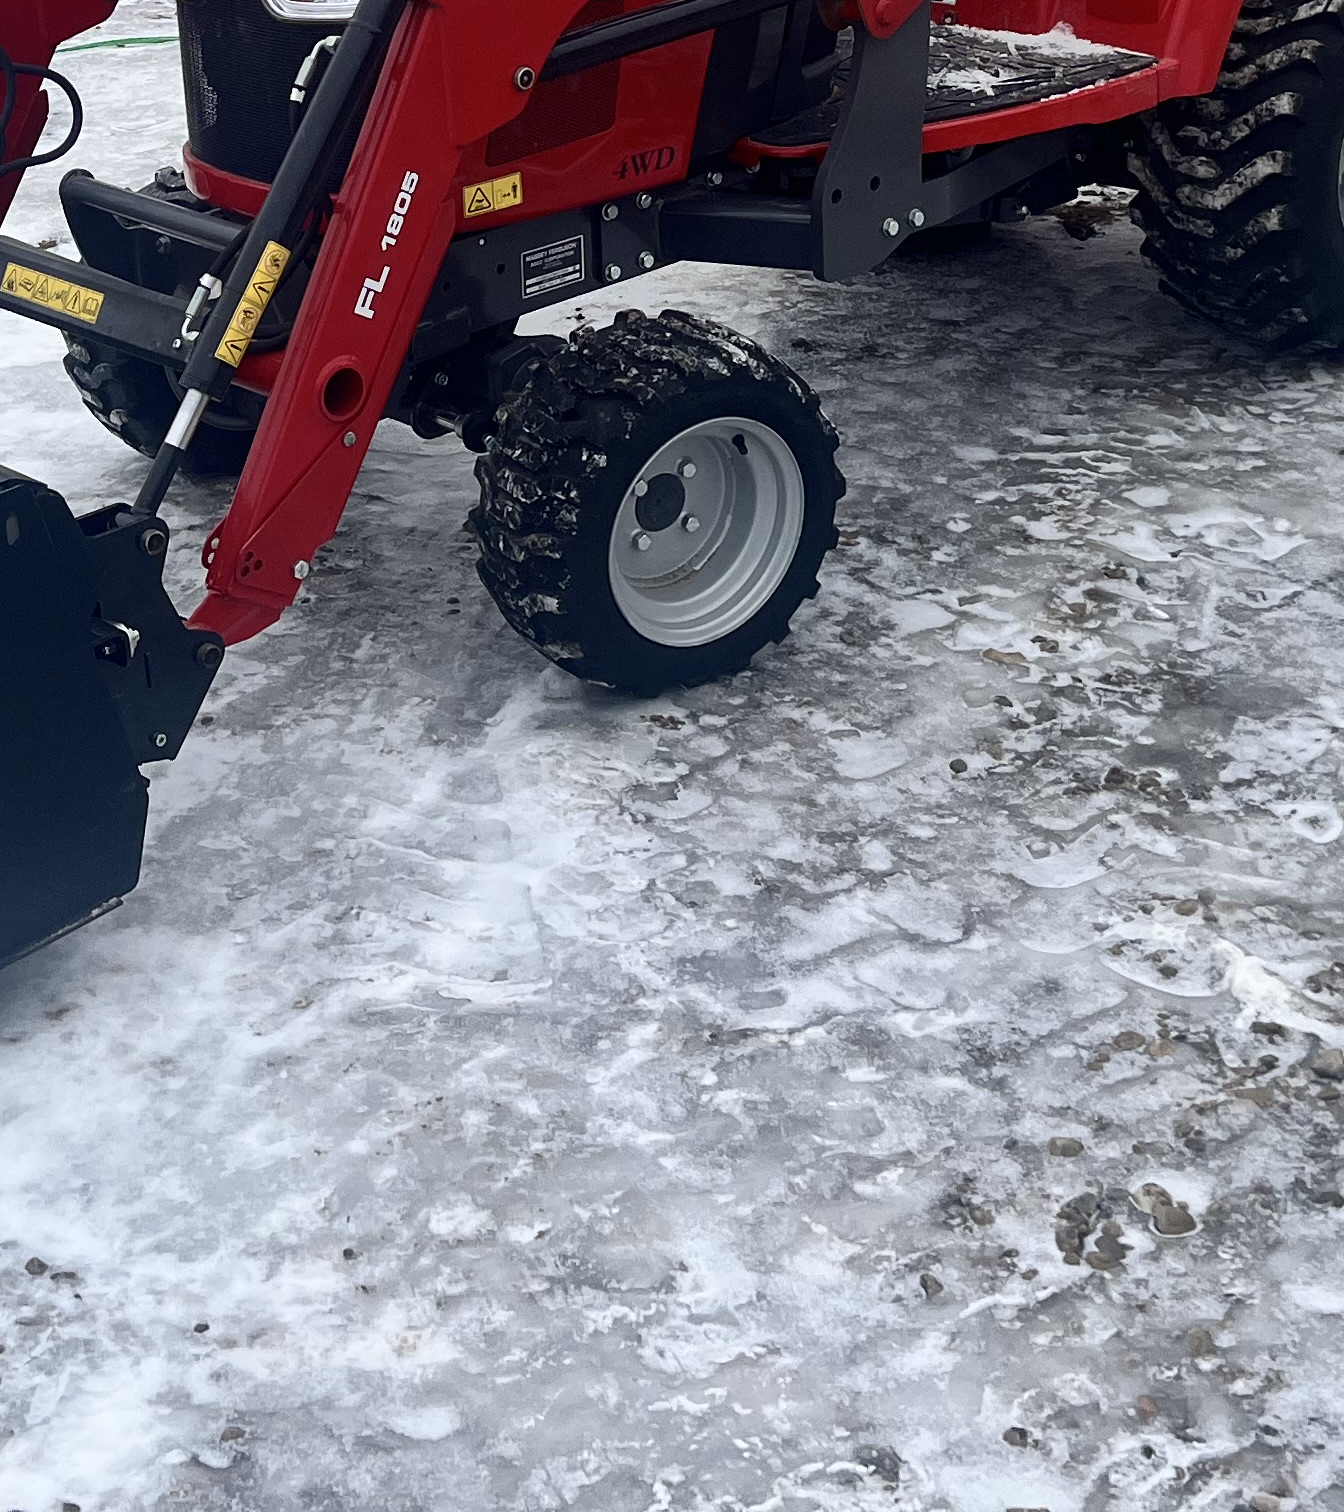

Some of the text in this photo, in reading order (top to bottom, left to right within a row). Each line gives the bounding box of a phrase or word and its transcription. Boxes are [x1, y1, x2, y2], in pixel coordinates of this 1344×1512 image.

[612, 146, 675, 180] 4WD
[354, 170, 419, 319] FL 1805
